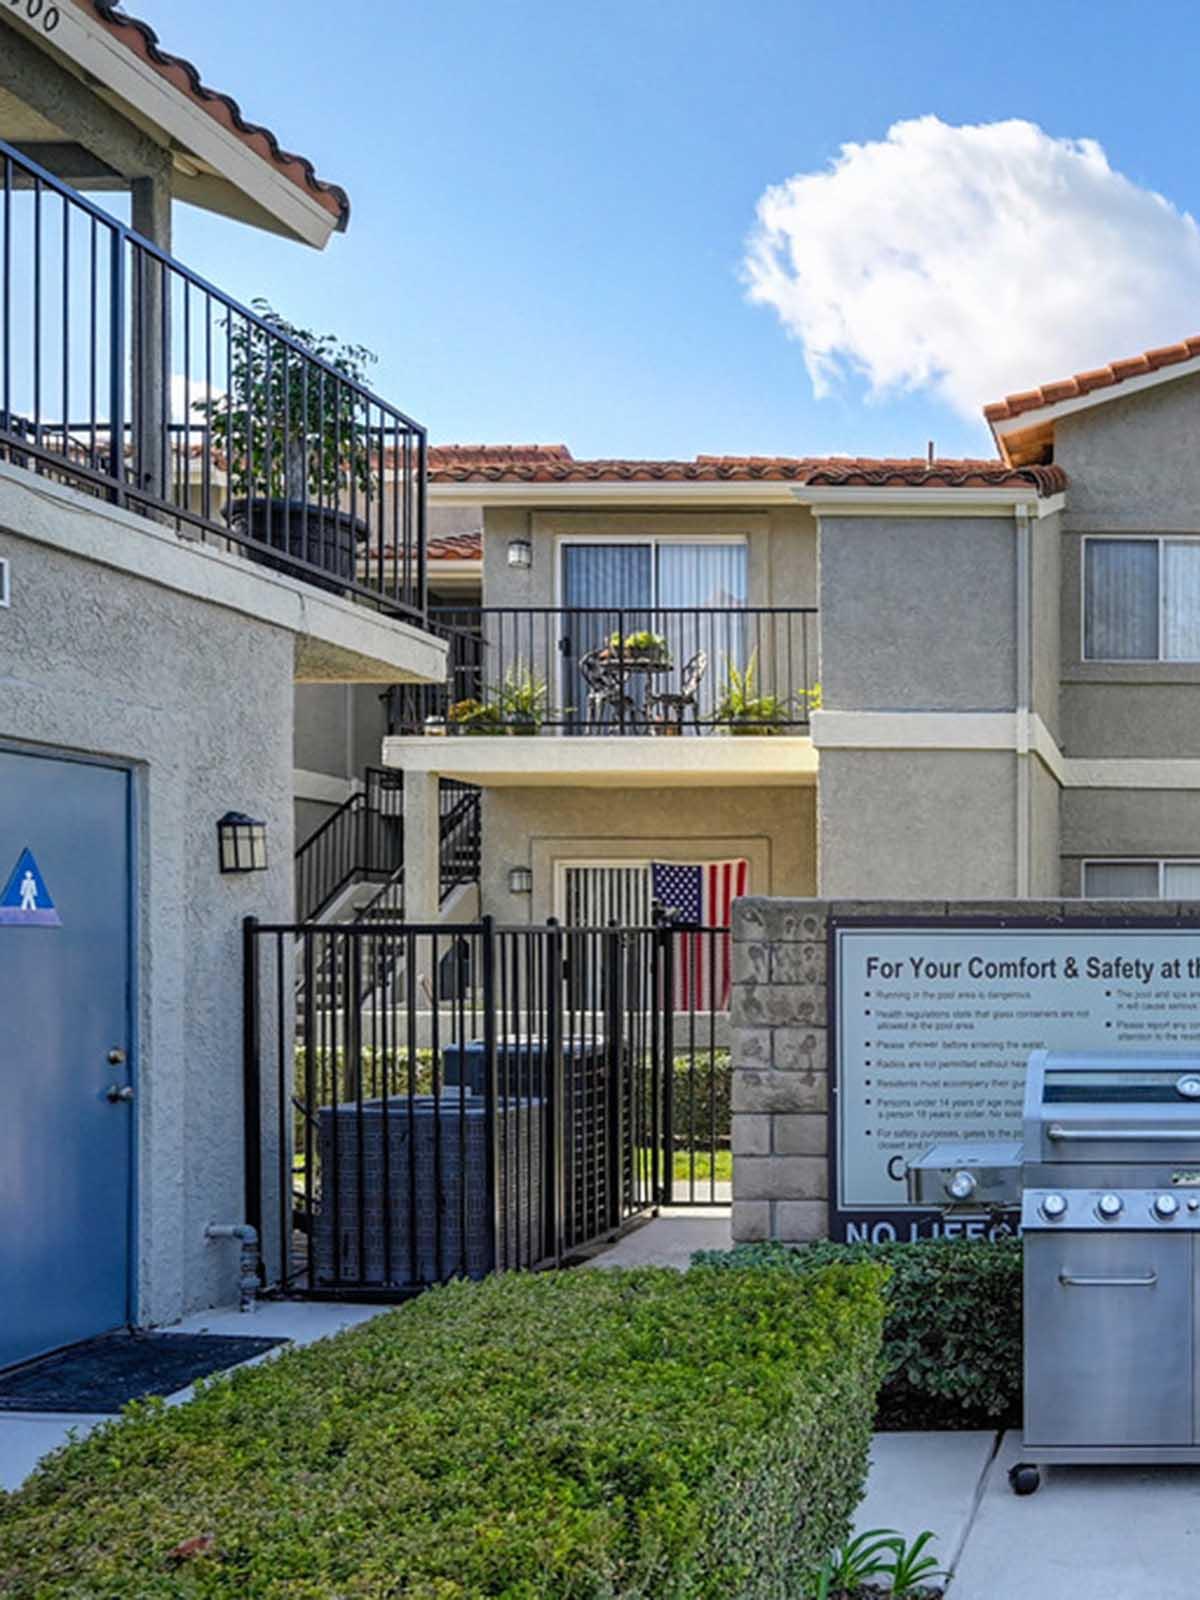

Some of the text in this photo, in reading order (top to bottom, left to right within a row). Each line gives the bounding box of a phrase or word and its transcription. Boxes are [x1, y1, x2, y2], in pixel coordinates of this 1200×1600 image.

[10, 0, 59, 31] 00
[866, 956, 903, 979] For
[909, 956, 962, 979] Your
[968, 956, 1057, 979] Comfort
[1063, 956, 1079, 979] &
[1086, 956, 1154, 984] Safety
[1160, 959, 1181, 979] at
[846, 1221, 897, 1244] NO
